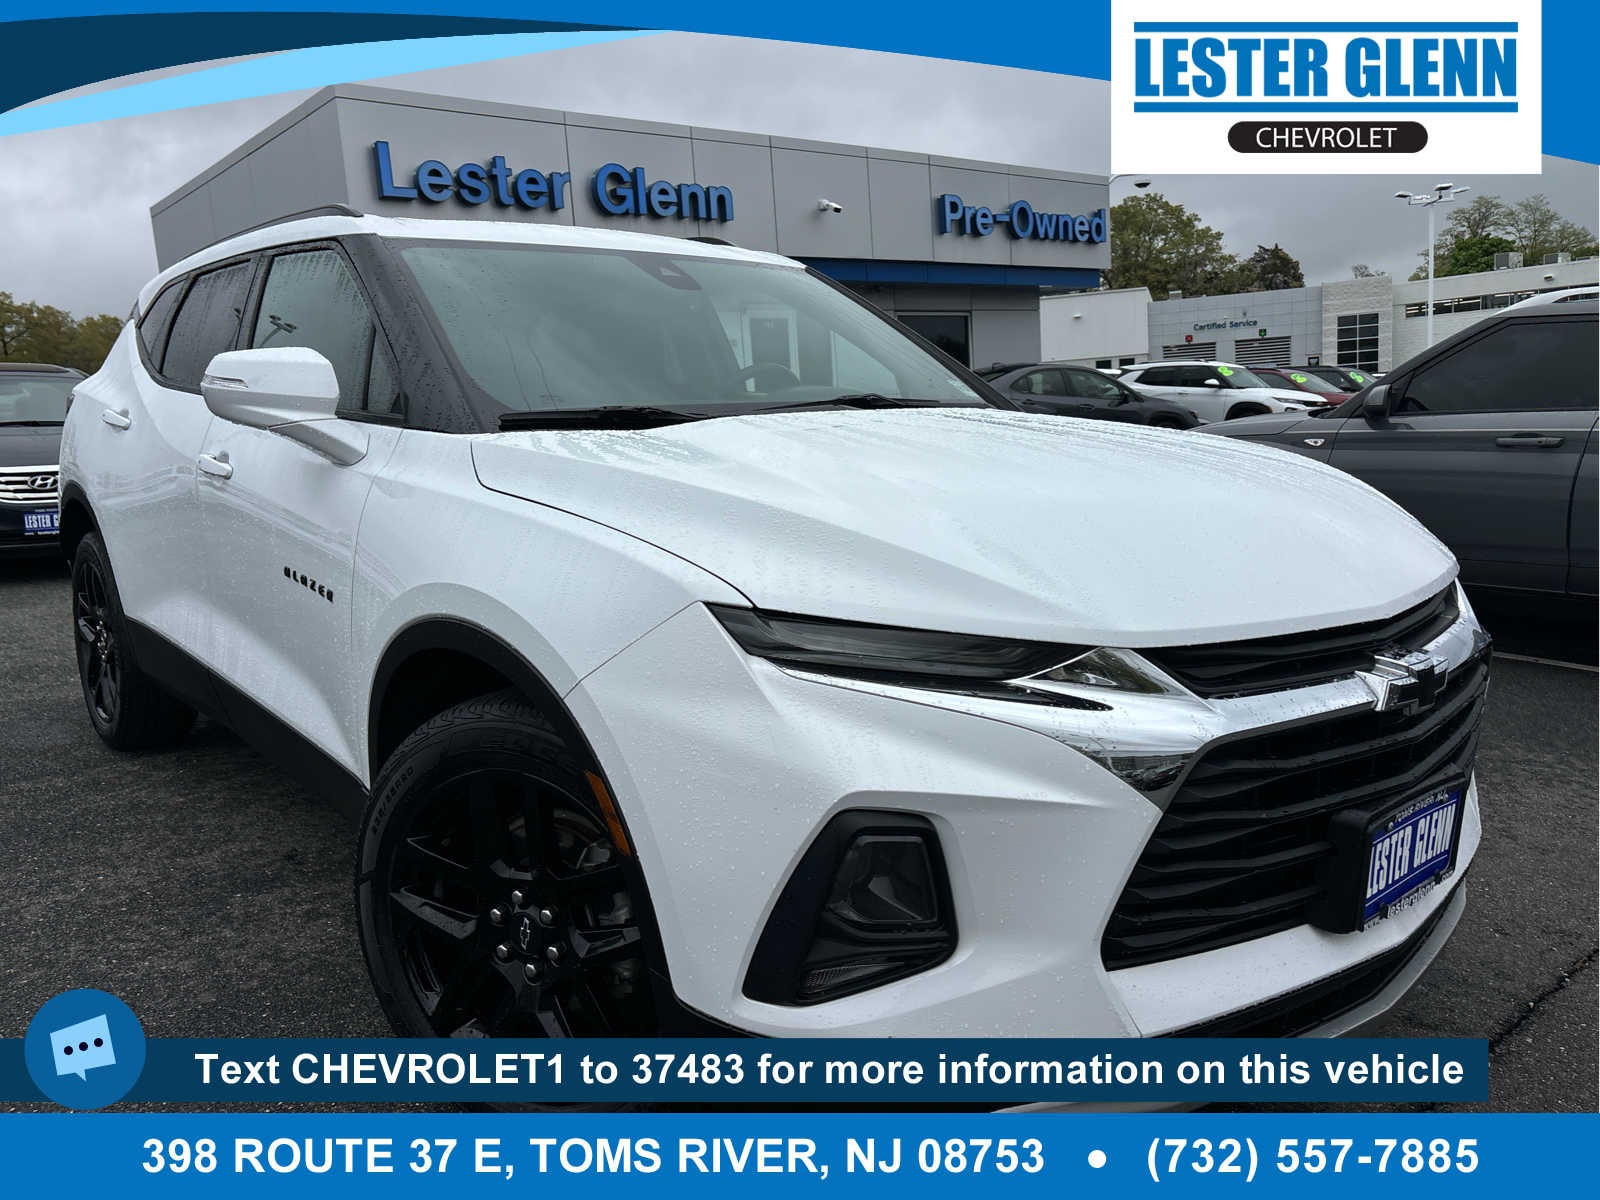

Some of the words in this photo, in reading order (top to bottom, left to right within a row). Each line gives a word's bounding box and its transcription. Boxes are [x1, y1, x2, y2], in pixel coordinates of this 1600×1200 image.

[374, 140, 571, 210] Lester
[593, 162, 735, 222] Glenn
[938, 193, 1107, 244] Pre-Owned
[1193, 321, 1227, 331] Certified
[1229, 319, 1258, 329] Service
[24, 513, 52, 529] LESTER
[283, 565, 334, 604] BLAZER
[1366, 825, 1413, 899] LESTER
[1413, 803, 1456, 868] GLENN
